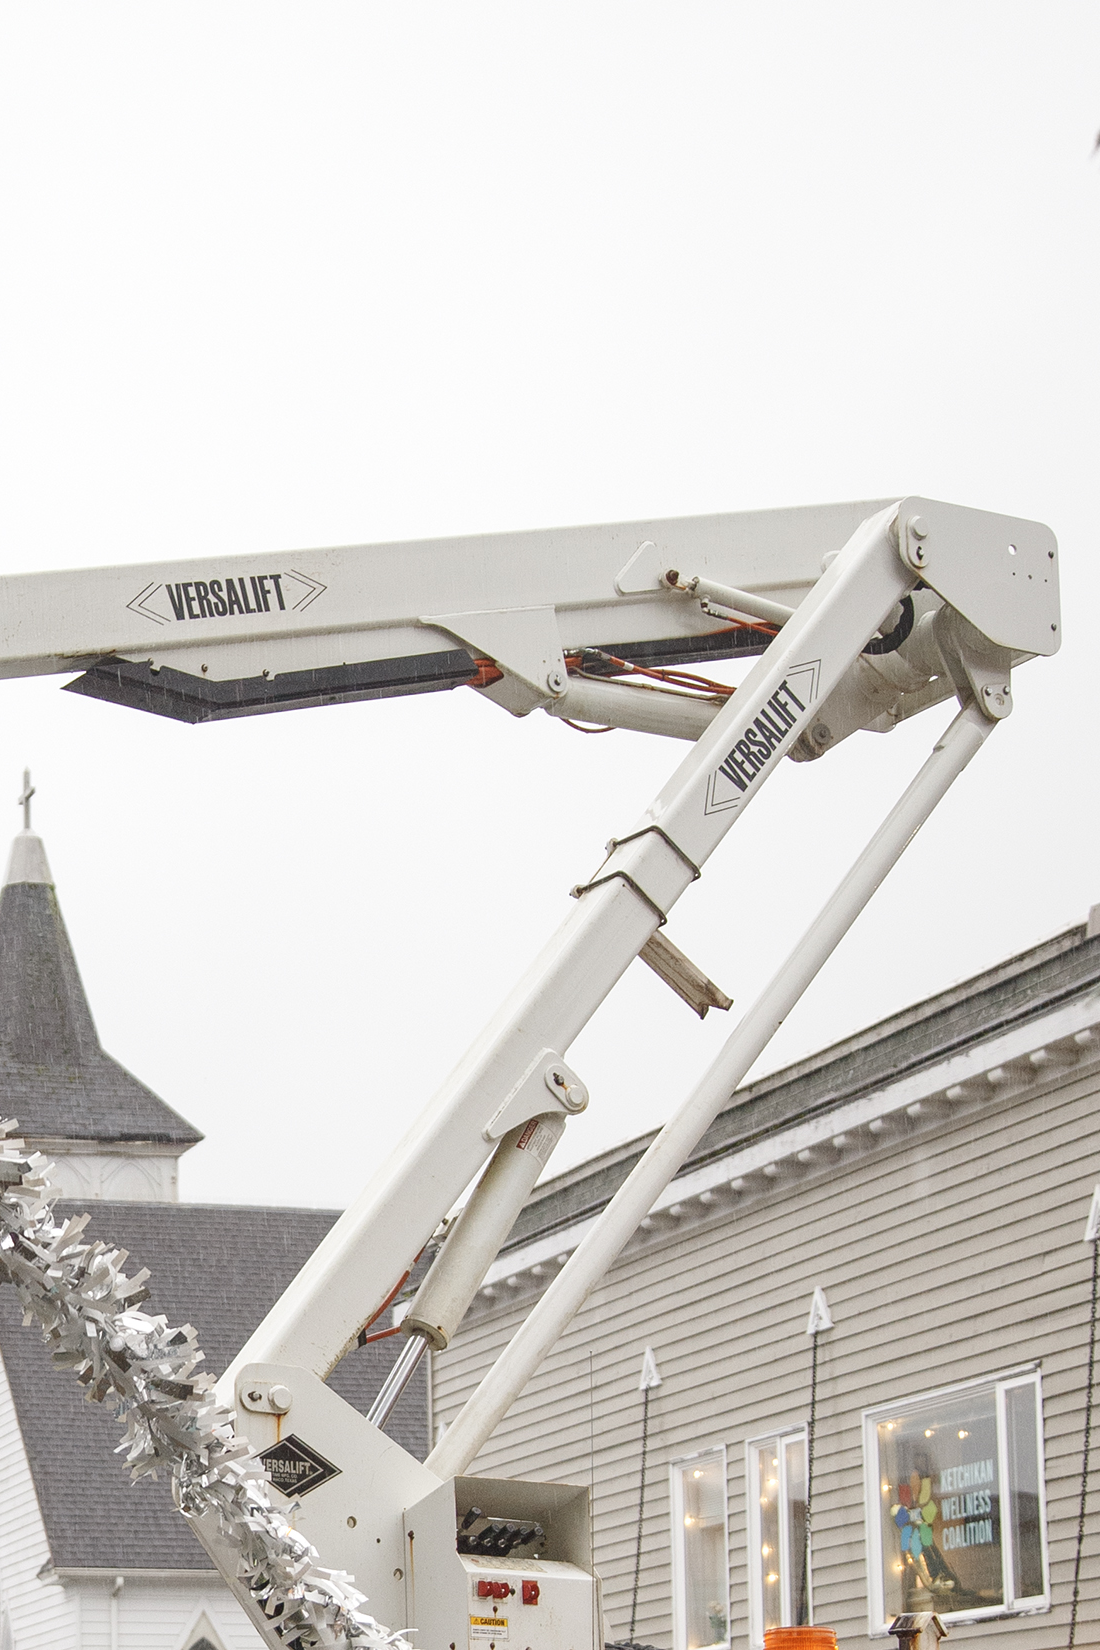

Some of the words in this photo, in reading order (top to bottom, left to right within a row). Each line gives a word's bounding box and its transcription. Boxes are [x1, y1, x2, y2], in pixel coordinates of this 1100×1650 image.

[165, 574, 286, 621] VERSALIFT
[718, 679, 806, 792] VERSALIFT
[940, 1459, 994, 1493] KETCHIKAN
[941, 1489, 992, 1521] WELLNESS
[942, 1519, 993, 1550] COALITION
[480, 1618, 505, 1626] CAUTION
